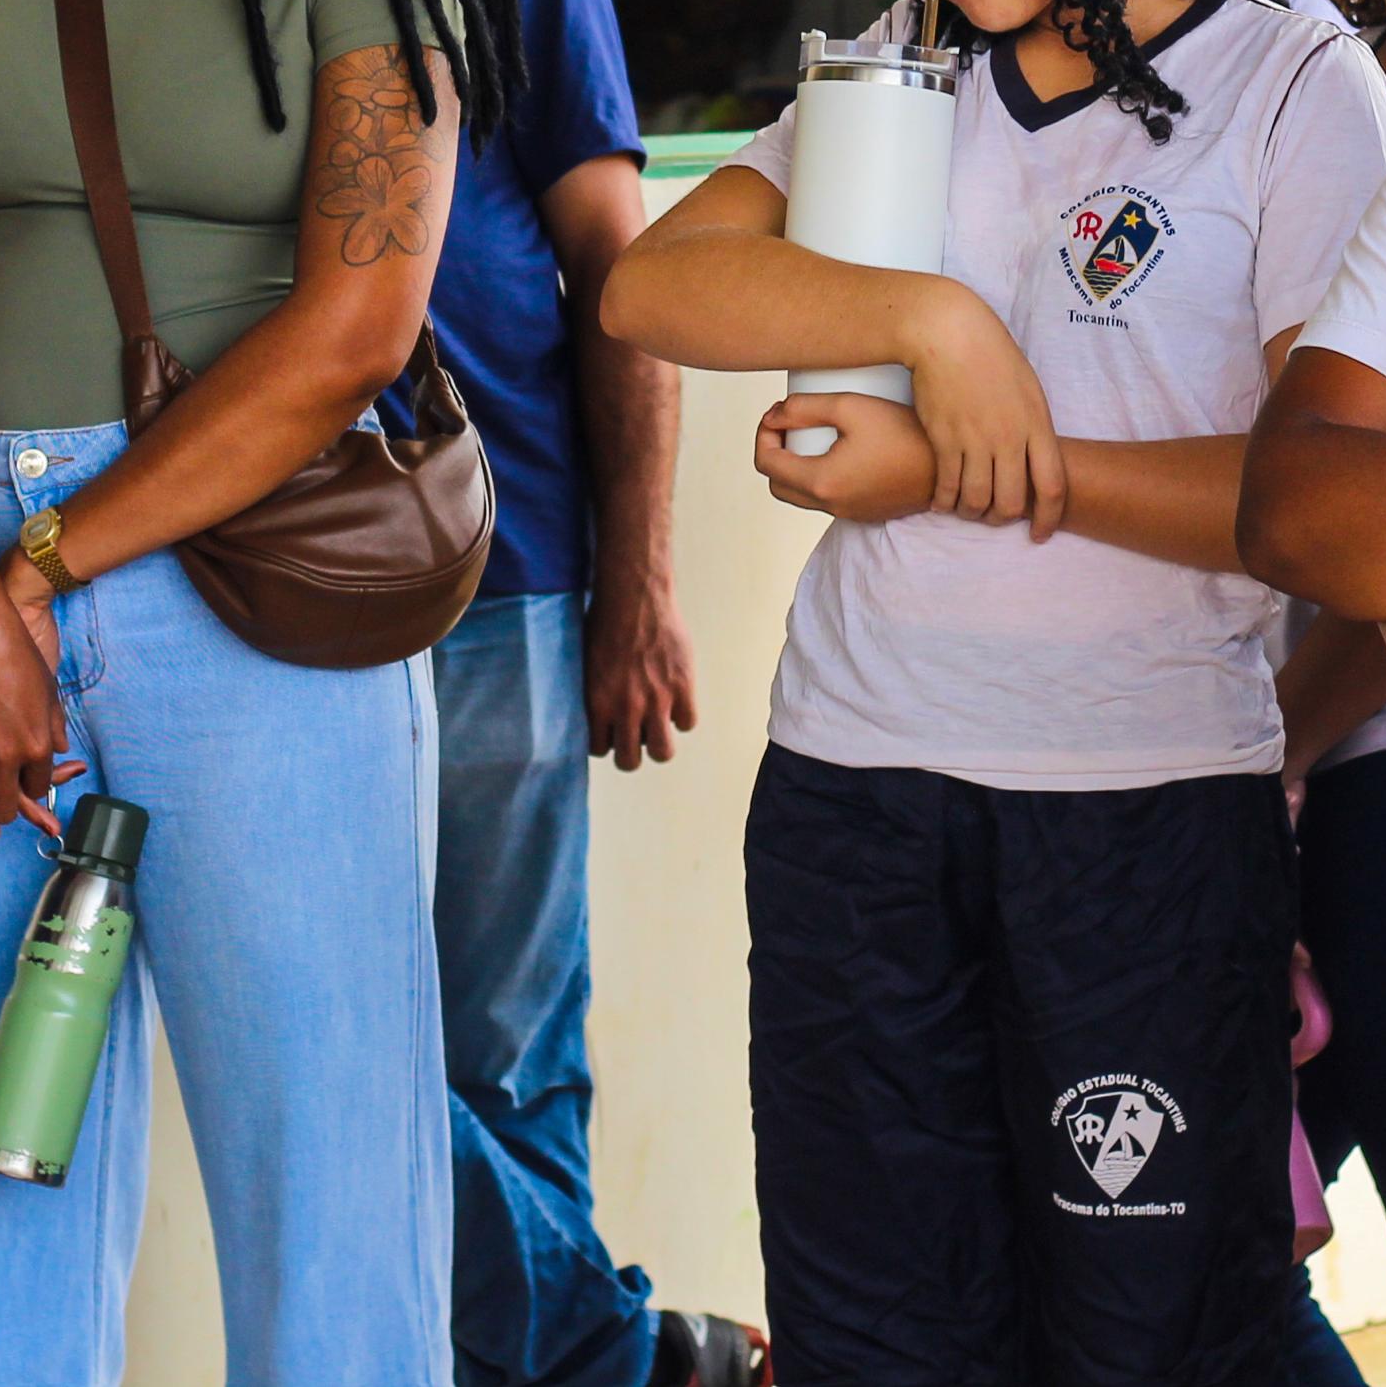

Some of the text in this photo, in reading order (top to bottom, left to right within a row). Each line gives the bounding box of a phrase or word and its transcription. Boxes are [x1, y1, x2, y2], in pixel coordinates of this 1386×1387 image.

[1060, 185, 1176, 236] COLEGIO TOCANTINS
[1058, 247, 1165, 310] Miracema do Tocantins
[1067, 309, 1129, 330] Tocantins
[1077, 1074, 1138, 1094] ESTADUAL
[1141, 1079, 1187, 1133] TOCANTINS
[1112, 1202, 1186, 1216] Tocantins-TO
